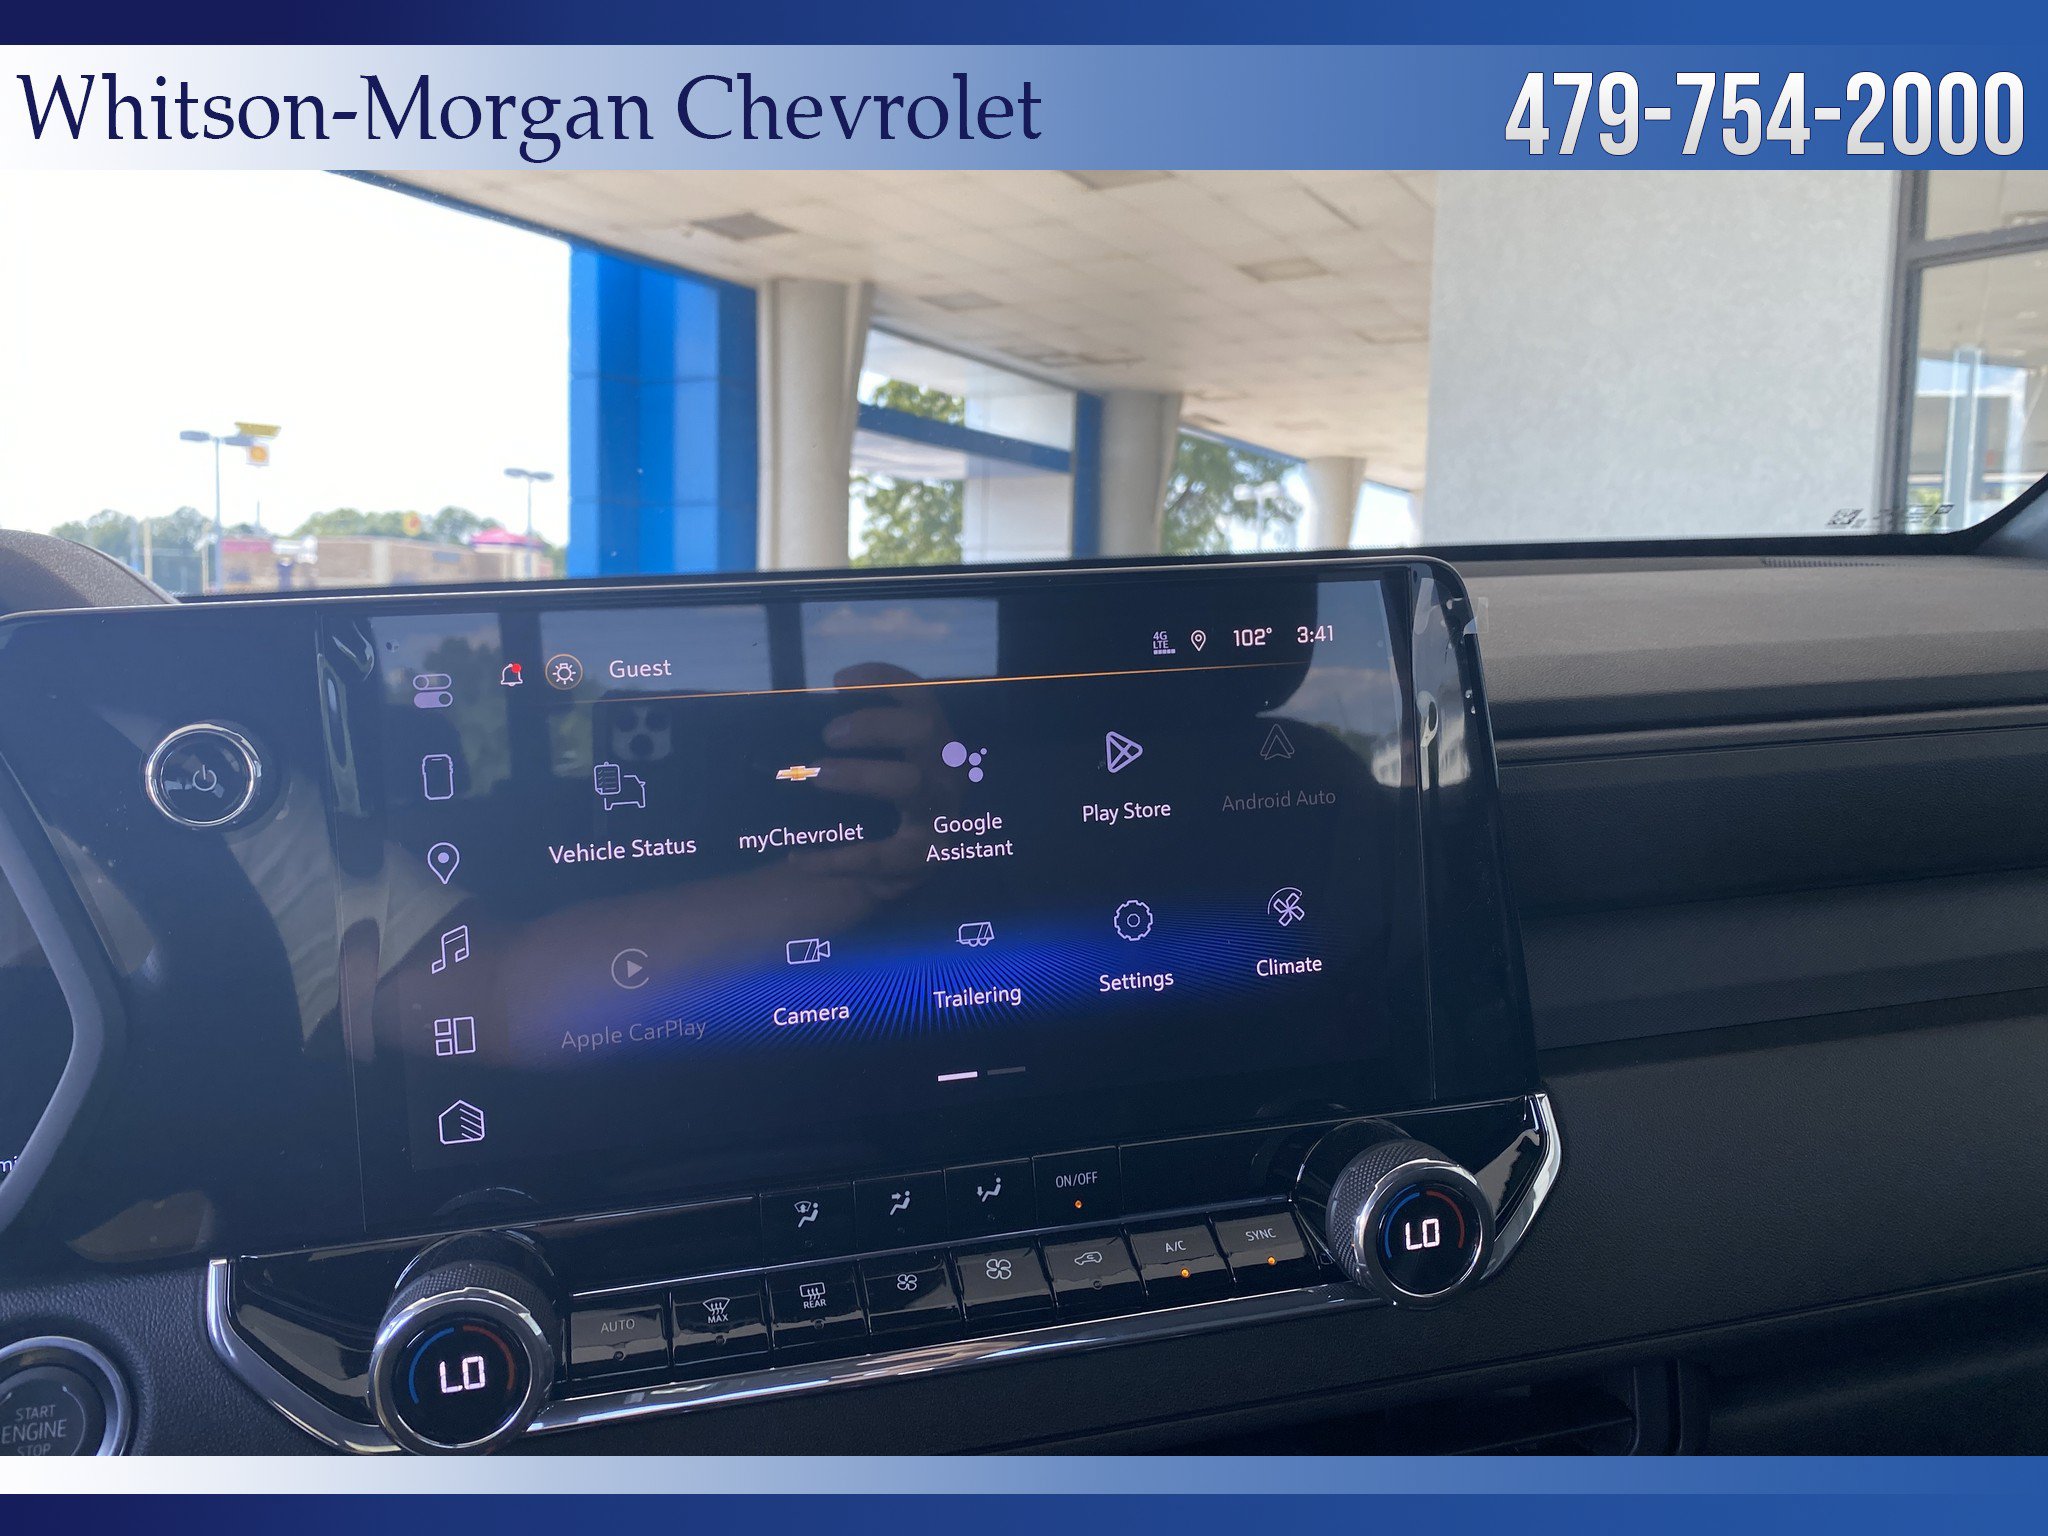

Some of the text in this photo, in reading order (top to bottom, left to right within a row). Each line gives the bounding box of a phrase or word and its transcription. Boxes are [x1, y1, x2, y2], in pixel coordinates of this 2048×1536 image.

[1153, 631, 1168, 641] 4G
[1153, 640, 1169, 650] LTE
[1233, 627, 1273, 647] 102°
[1296, 625, 1334, 644] 3:41
[608, 658, 672, 679] Guest
[1222, 789, 1337, 812] Android Auto
[933, 811, 1003, 836] Google
[1082, 800, 1171, 826] Play Store
[738, 823, 864, 853] myChevrolet
[548, 837, 698, 865] Vehicle Status
[926, 839, 1014, 863] Assistant
[1256, 955, 1323, 978] Climate
[1098, 971, 1175, 993] Settings
[933, 985, 1022, 1010] Trailering
[773, 1004, 850, 1027] Camera
[561, 1018, 707, 1052] Apple CarPlay
[1055, 1170, 1098, 1188] ON/OFF
[1245, 1228, 1277, 1243] SYNC
[1405, 1218, 1440, 1250] LO
[1164, 1239, 1187, 1254] A/C
[803, 1298, 827, 1309] REAR
[600, 1318, 636, 1334] AUTO
[707, 1313, 729, 1324] MAX
[439, 1355, 486, 1394] LO
[15, 1404, 56, 1421] START
[2, 1419, 67, 1444] ENGINE
[17, 1443, 51, 1456] STOP
